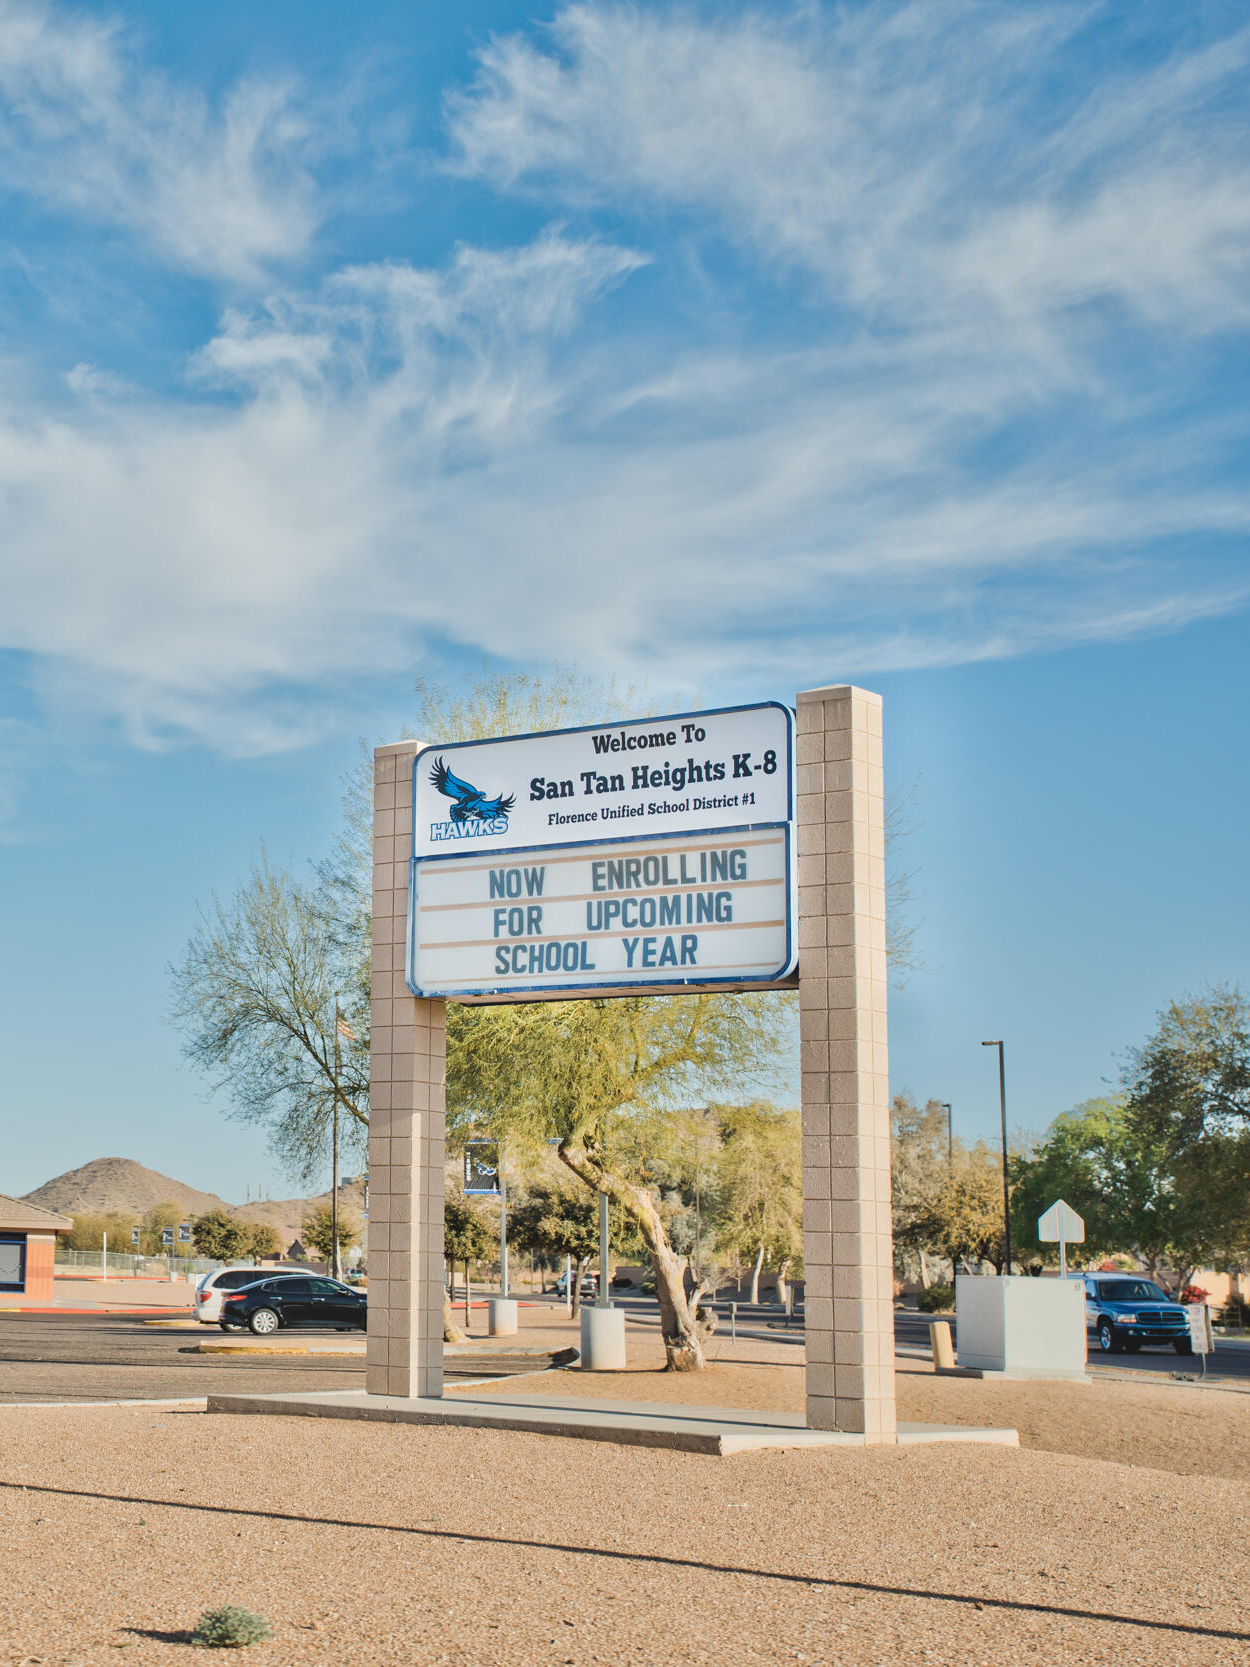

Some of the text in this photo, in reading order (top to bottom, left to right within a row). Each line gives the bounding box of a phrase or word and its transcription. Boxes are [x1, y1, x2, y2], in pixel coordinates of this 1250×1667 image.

[592, 724, 706, 754] Welcome To
[530, 749, 777, 801] San Tan Heights K-8
[430, 816, 509, 841] HAWKS
[548, 792, 756, 825] Florence Unified School District #1
[489, 849, 747, 899] NOW ENROLLING
[493, 891, 733, 938] FOR UPCOMING
[495, 934, 698, 975] SCHOOL YEAR
